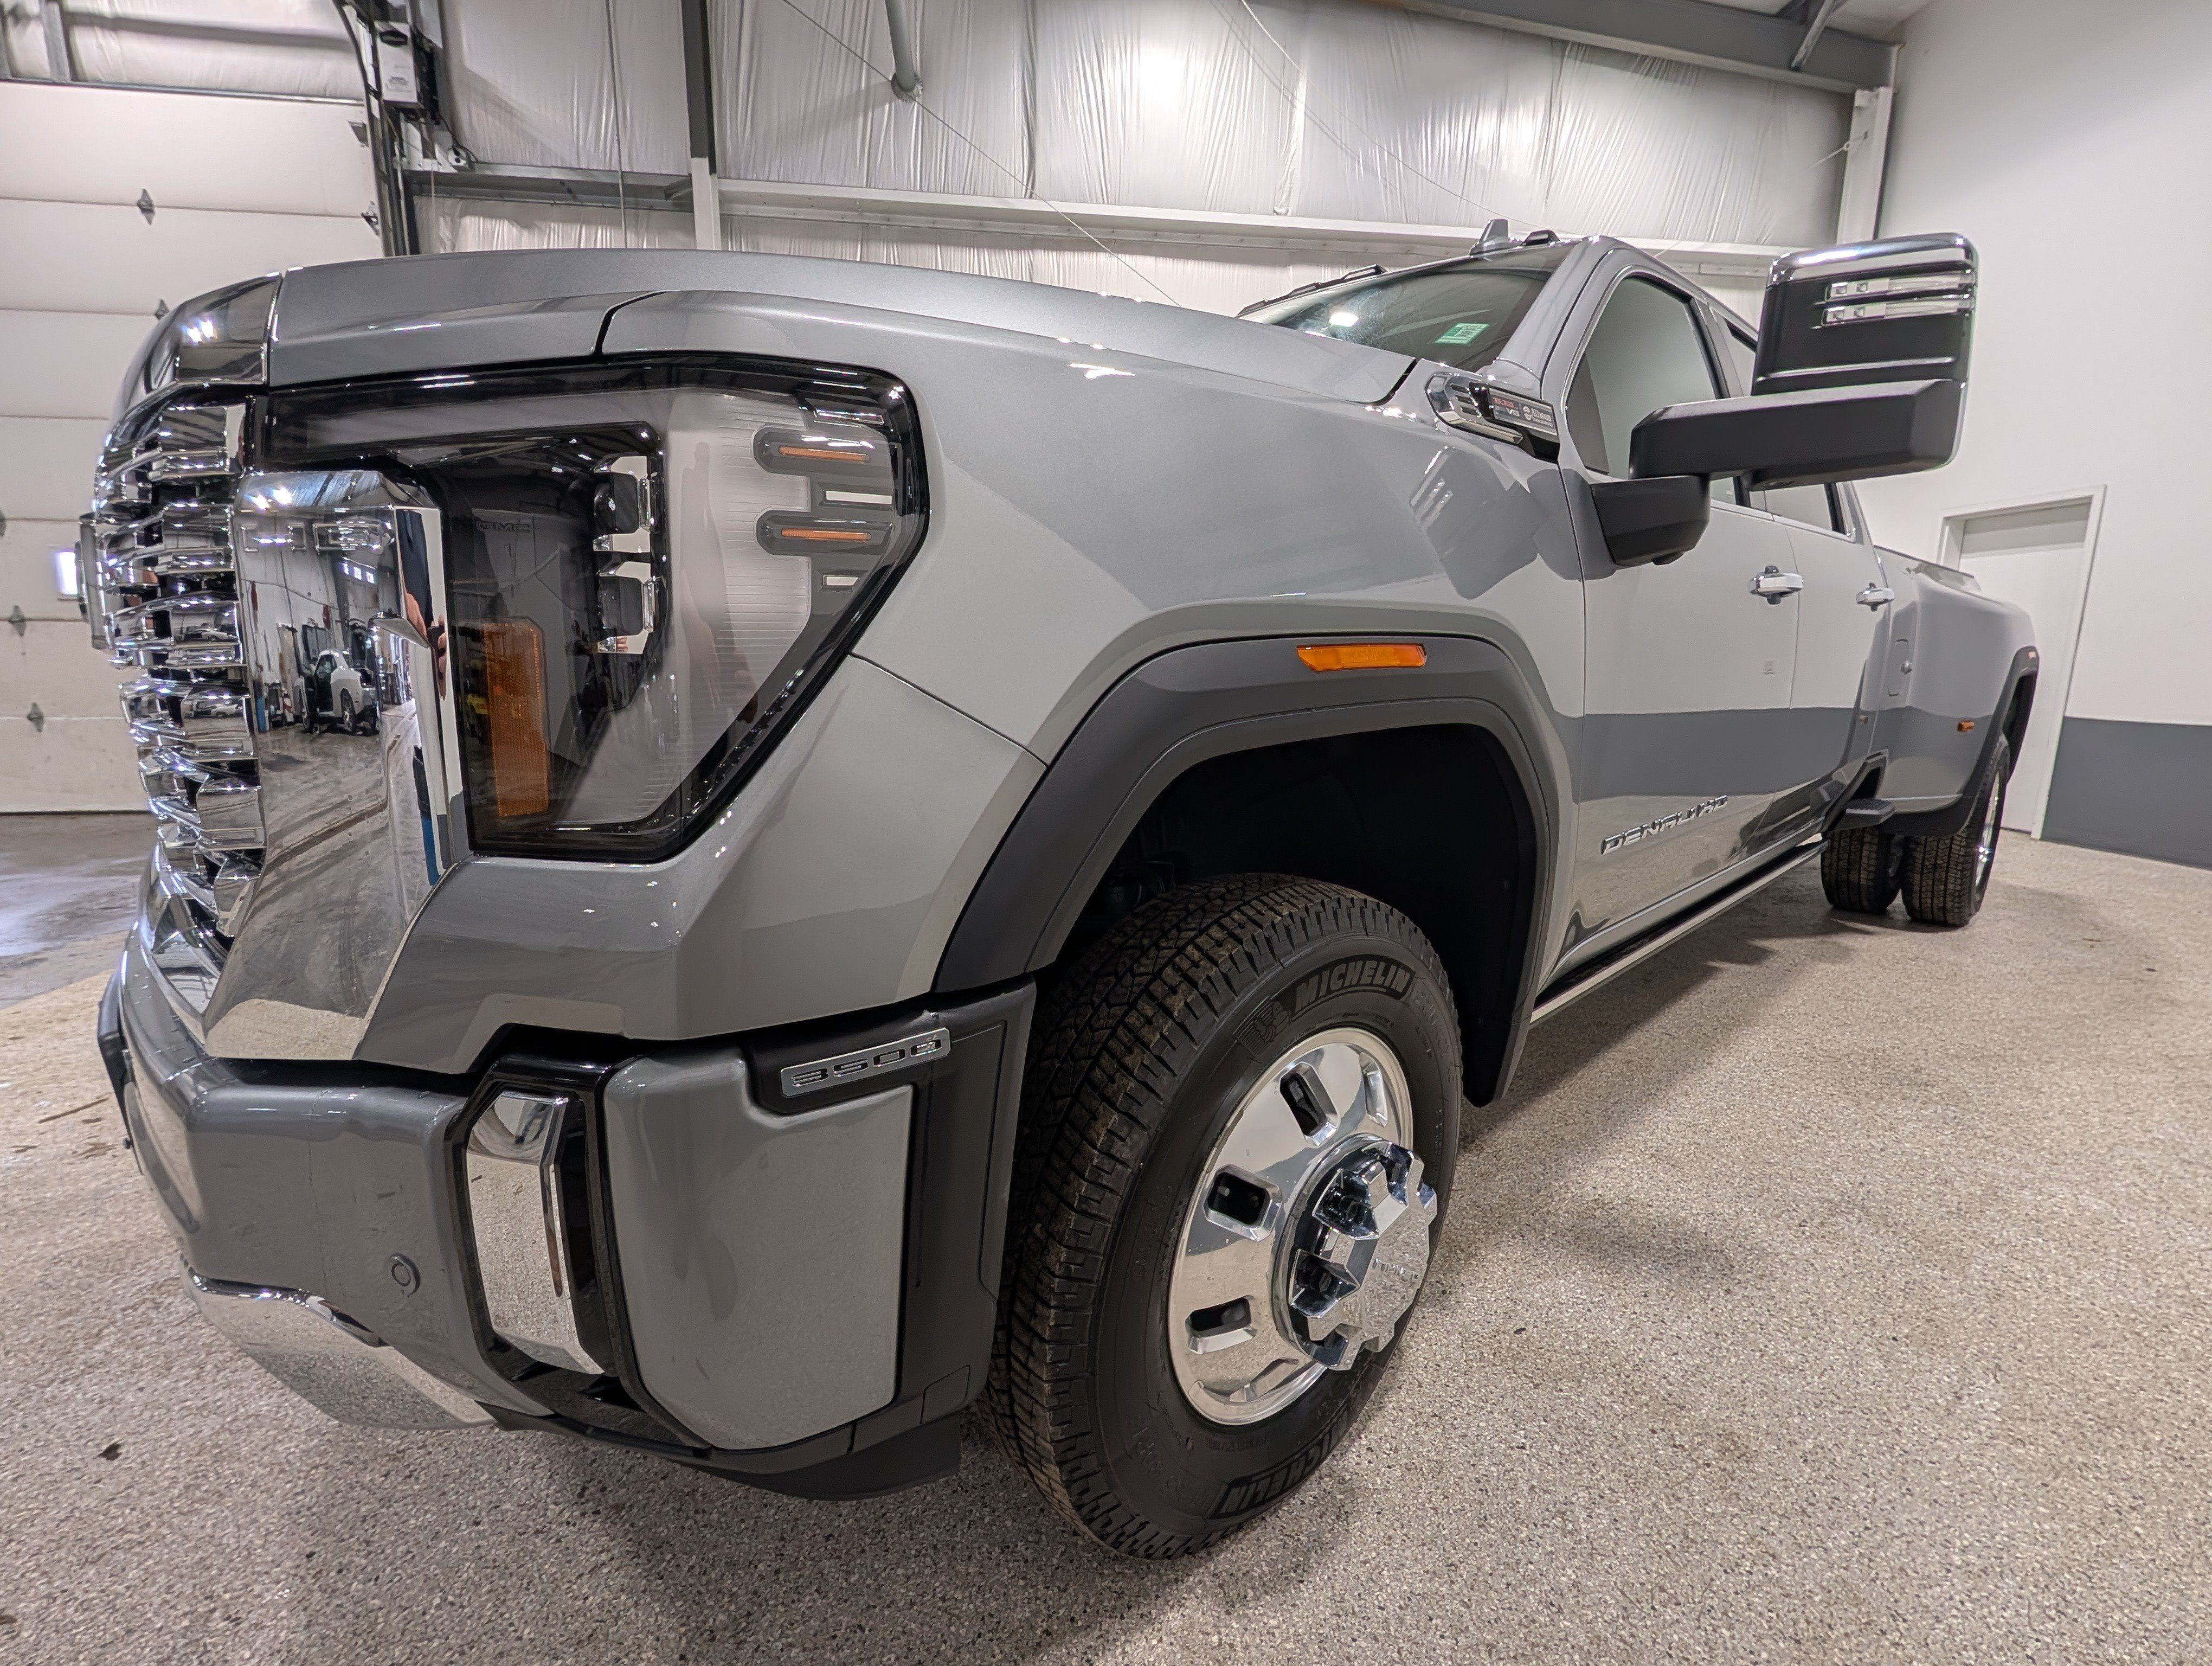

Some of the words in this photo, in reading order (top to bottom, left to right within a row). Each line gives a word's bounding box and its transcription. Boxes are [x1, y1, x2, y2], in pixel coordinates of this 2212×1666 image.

[476, 521, 531, 533] GMC
[1295, 960, 1410, 1014] MICHELIN
[791, 1039, 942, 1087] 3500
